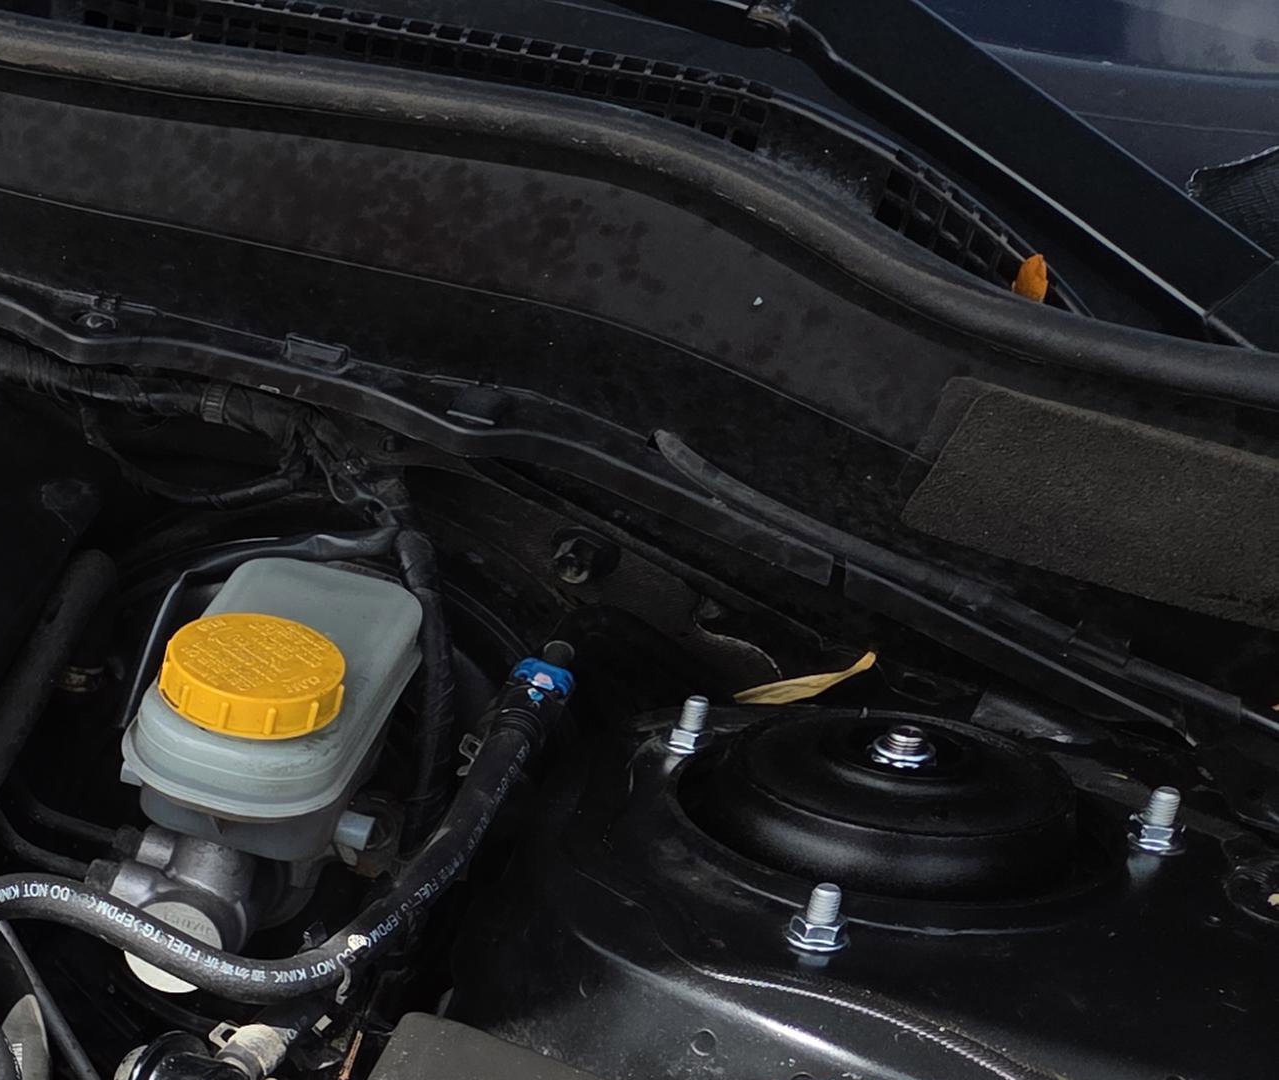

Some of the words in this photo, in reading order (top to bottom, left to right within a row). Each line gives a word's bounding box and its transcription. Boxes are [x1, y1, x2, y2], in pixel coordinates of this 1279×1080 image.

[22, 882, 49, 896] NOT
[50, 885, 69, 899] DO
[161, 932, 203, 960] FUEL
[306, 956, 337, 979] NOT
